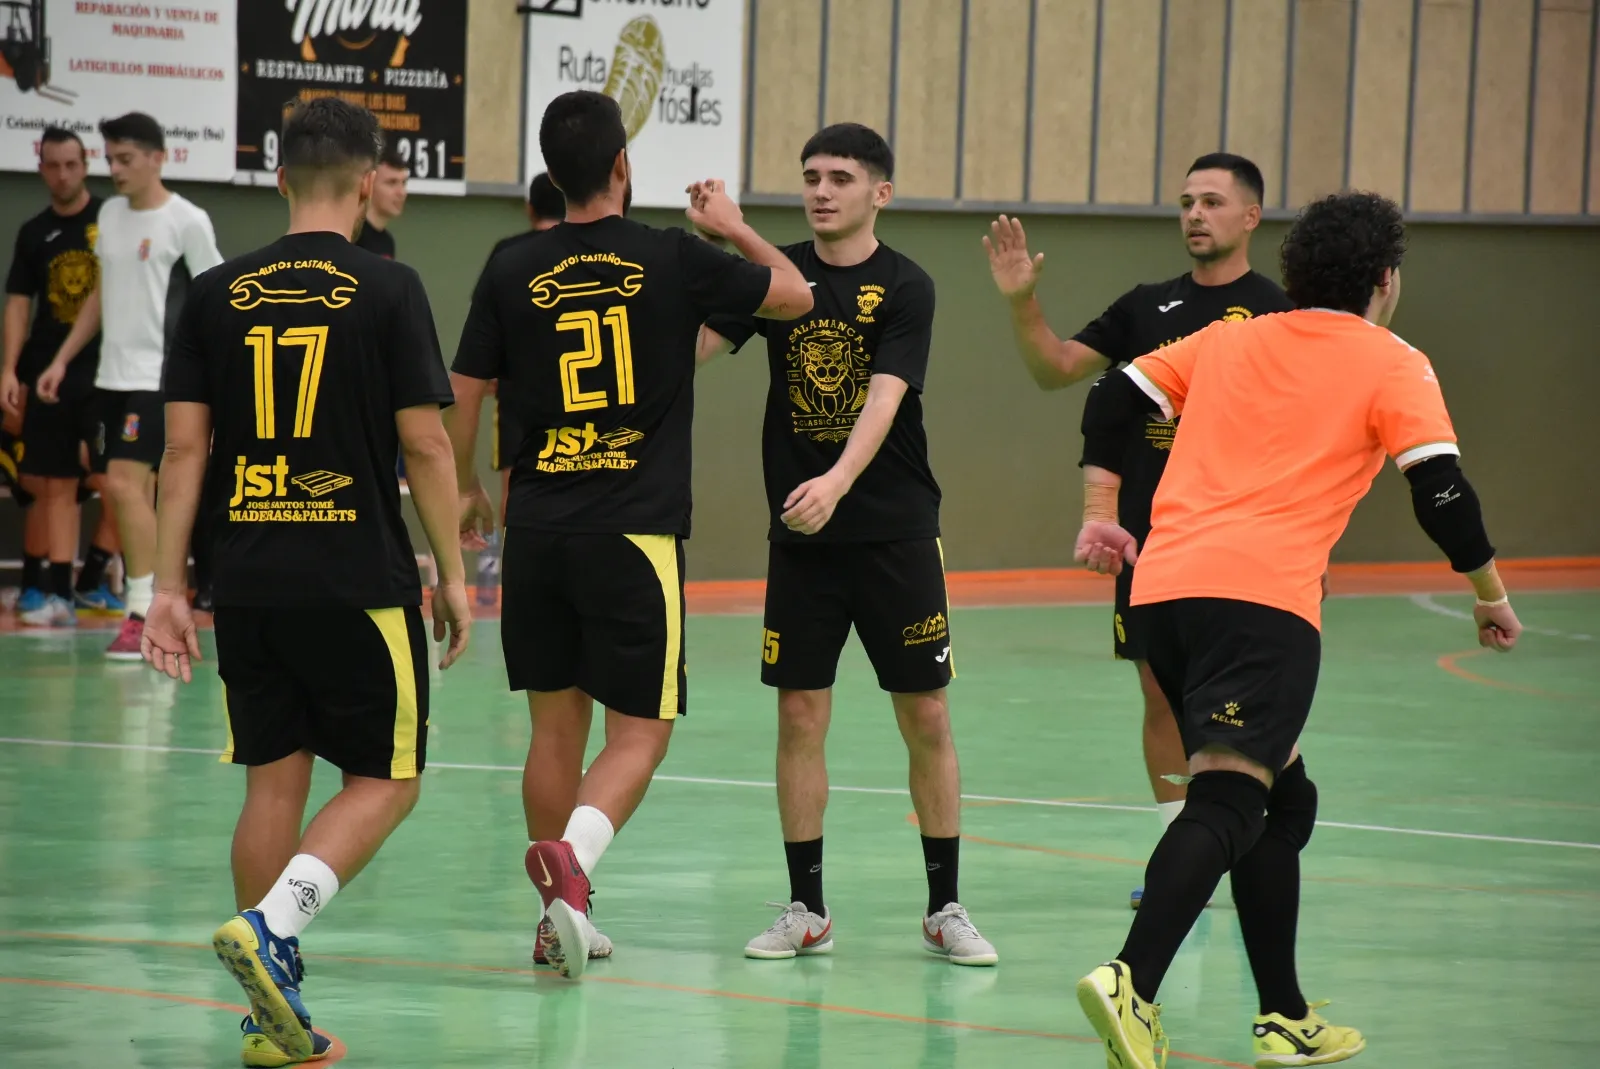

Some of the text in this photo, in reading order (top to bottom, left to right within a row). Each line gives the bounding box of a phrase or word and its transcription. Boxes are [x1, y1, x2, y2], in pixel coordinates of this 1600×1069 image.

[112, 22, 185, 40] MAQUINARIA
[255, 59, 449, 89] RESTAURANTE PIZZERÍA
[558, 46, 606, 83] Ruta
[665, 61, 714, 87] huellas
[658, 86, 722, 126] fóses
[258, 260, 337, 276] AUTOS CASTAÑO
[553, 252, 621, 275] AUTOS CASTAÑO
[788, 319, 864, 345] SALAMANCA
[555, 305, 635, 413] 21
[244, 325, 329, 439] 17
[799, 419, 832, 427] CLASSIC
[229, 455, 290, 507] jst
[229, 509, 357, 522] MADERAS&PALETS
[246, 499, 335, 509] JOSÉ SANTOS TOMÉ
[1211, 712, 1245, 728] KELME
